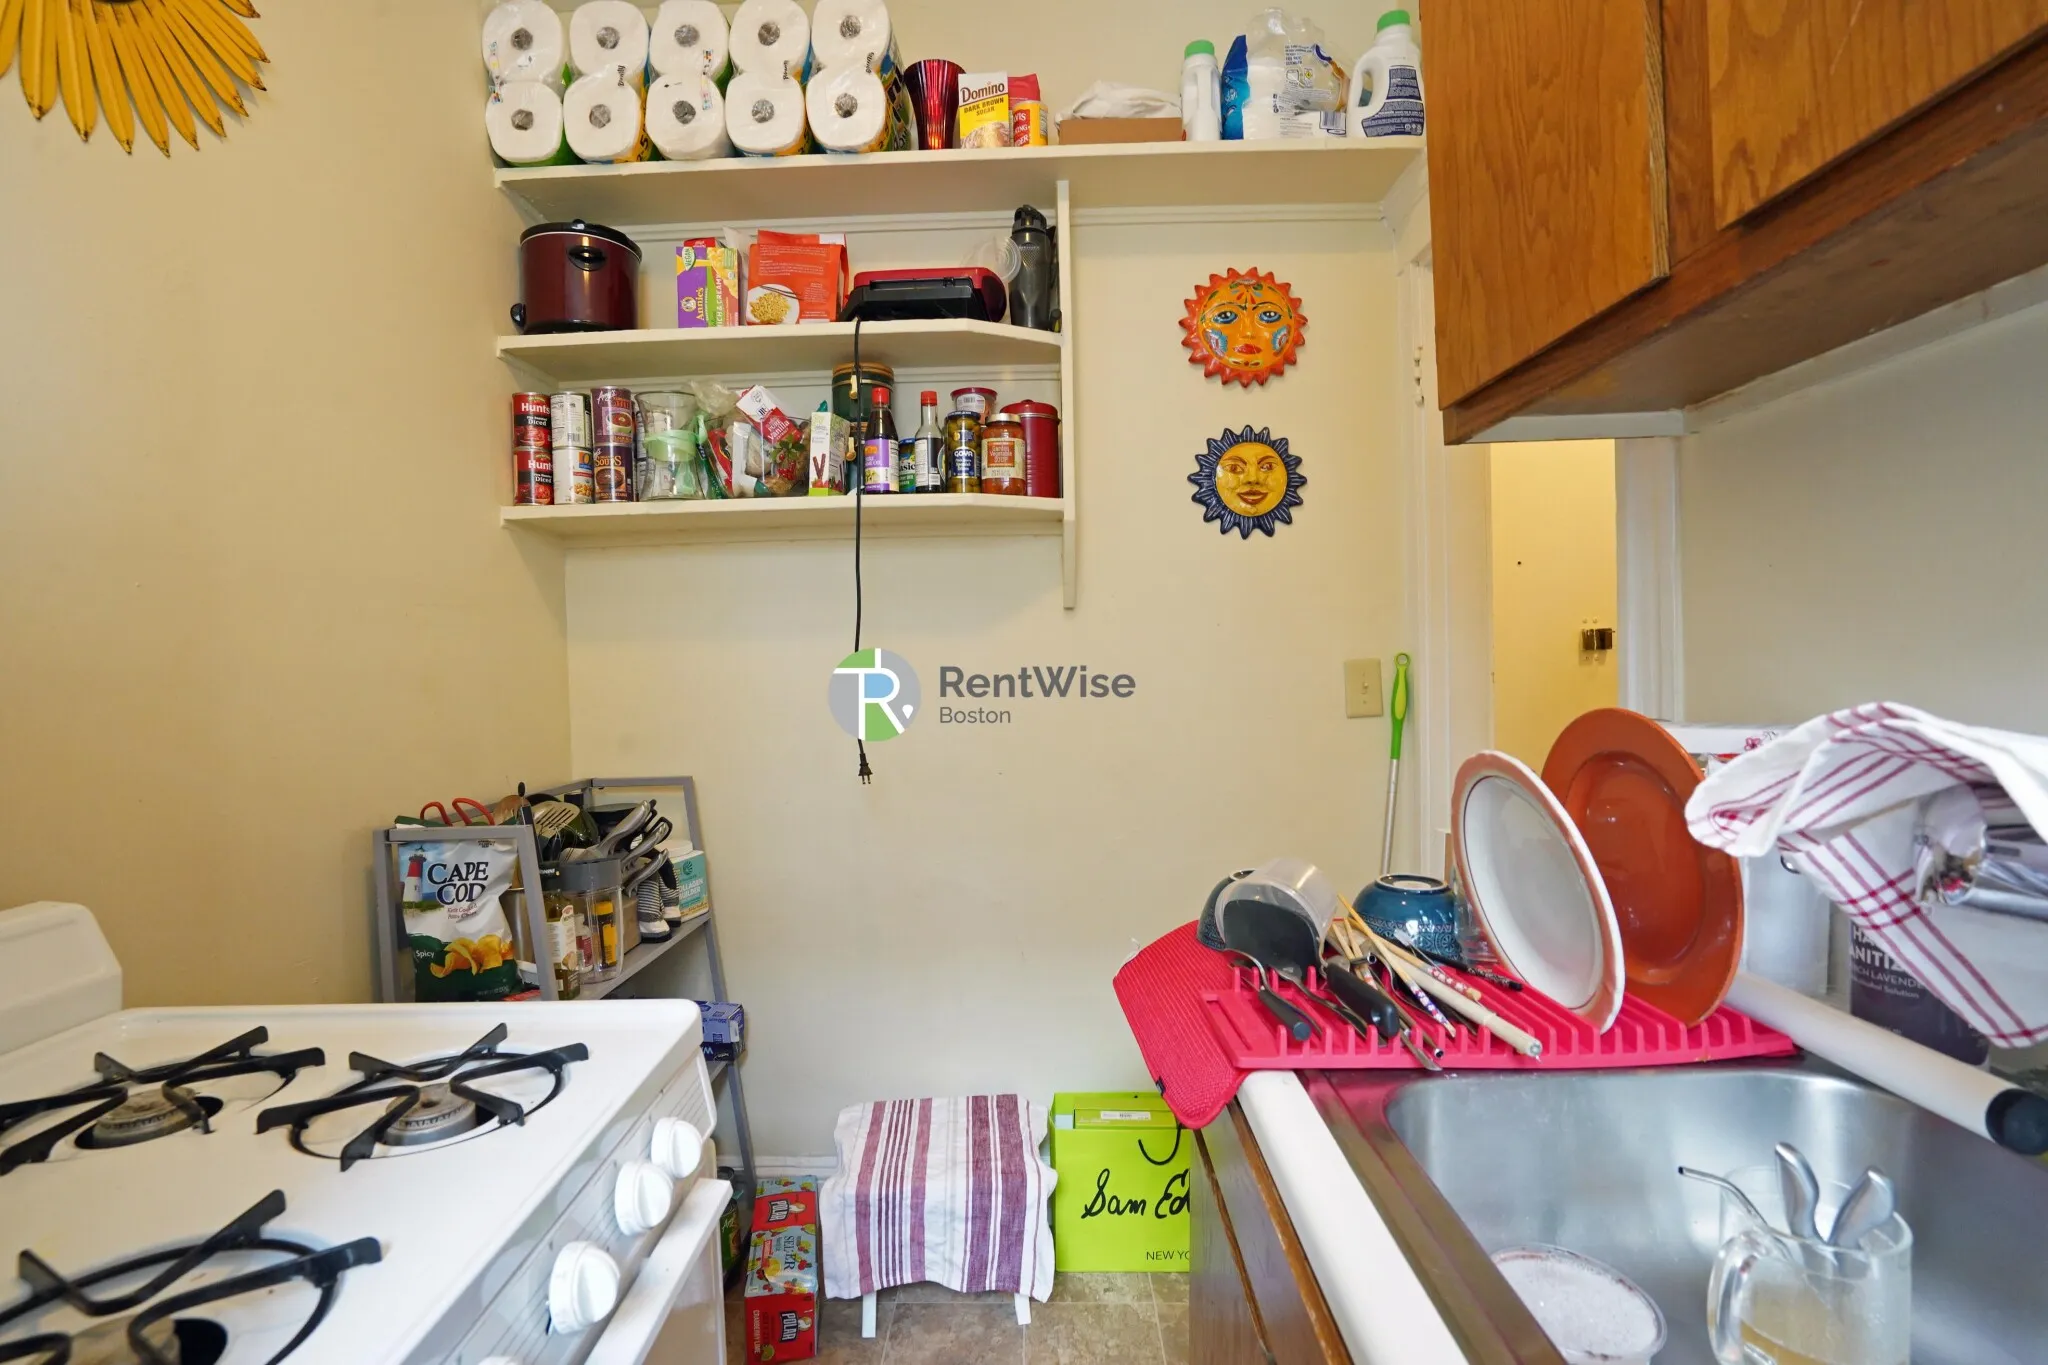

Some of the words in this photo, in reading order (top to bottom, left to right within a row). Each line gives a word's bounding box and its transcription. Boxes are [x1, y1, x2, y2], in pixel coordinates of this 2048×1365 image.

[960, 82, 1005, 103] Domino
[963, 101, 981, 114] DARK
[982, 96, 1005, 109] BROWN
[684, 248, 692, 267] VEGAN
[696, 286, 705, 321] Annie's
[528, 419, 547, 427] Diced
[767, 420, 790, 440] vanilla
[535, 476, 552, 484] Diced
[427, 861, 489, 886] CAPE
[436, 883, 487, 905] COD
[416, 950, 435, 958] Spicy
[1081, 1168, 1146, 1219] Sam
[1146, 1251, 1175, 1261] NEW
[781, 1312, 798, 1341] POLAR
